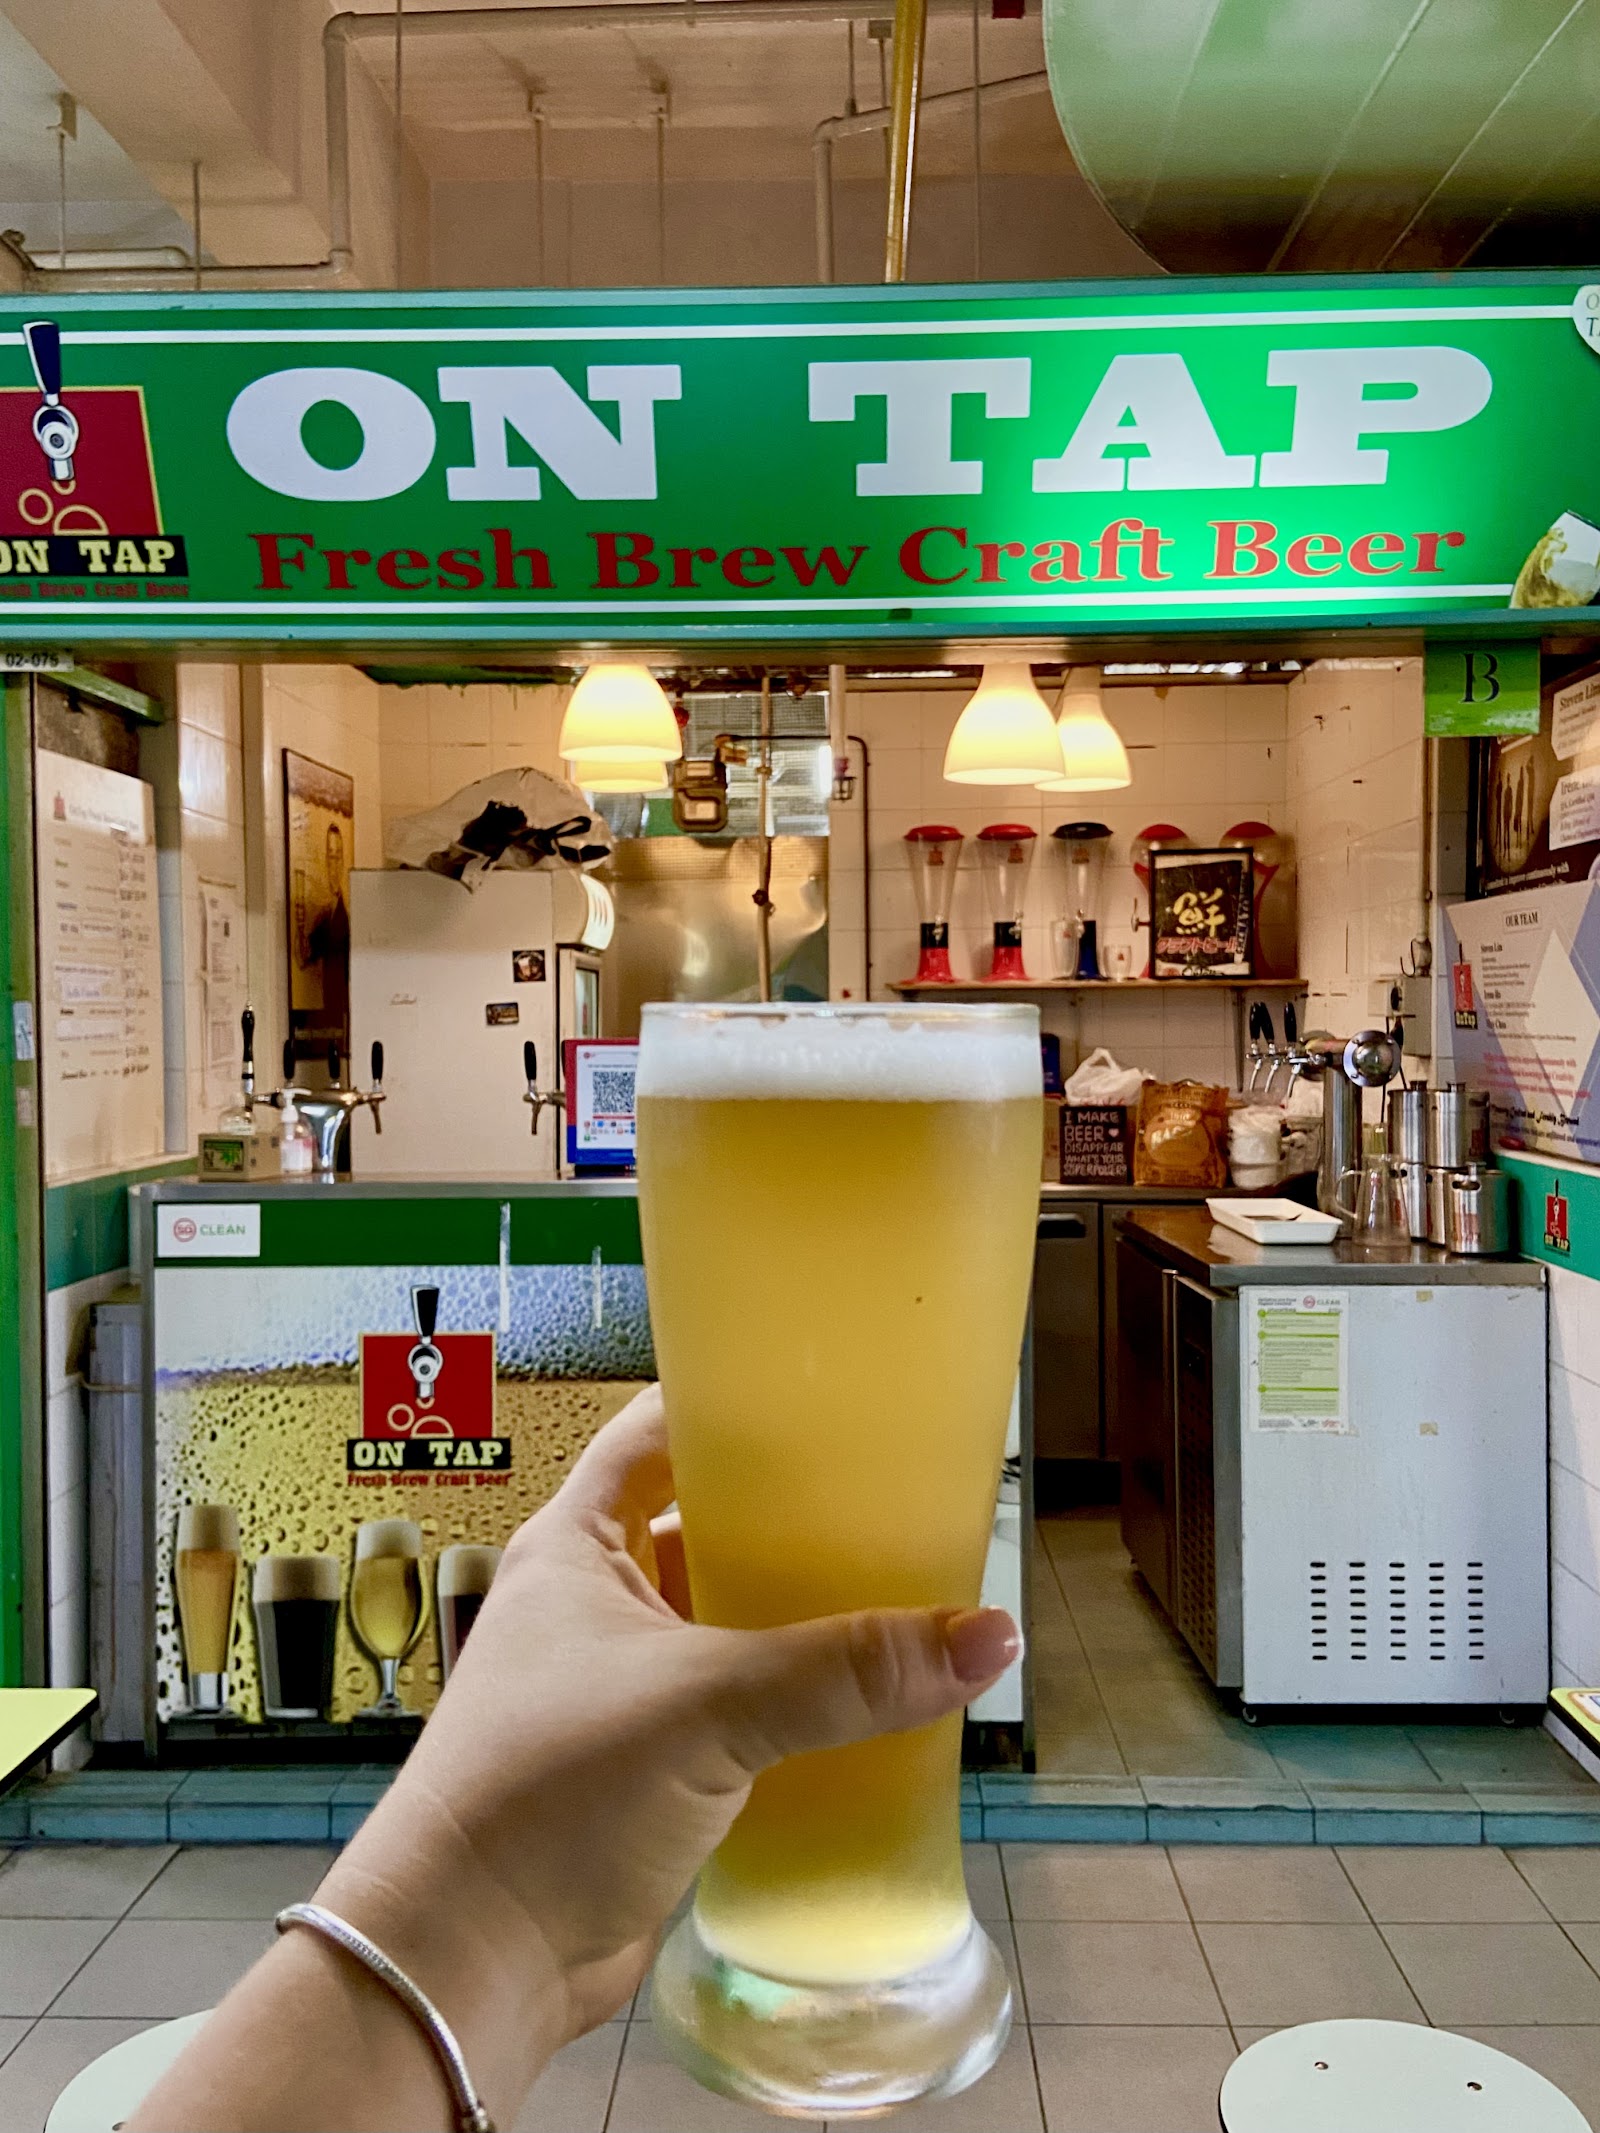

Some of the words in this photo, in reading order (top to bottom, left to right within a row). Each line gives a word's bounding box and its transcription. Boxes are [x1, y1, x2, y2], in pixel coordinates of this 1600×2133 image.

[226, 364, 682, 502] ON
[808, 346, 1493, 497] TAP
[78, 540, 175, 573] TAP
[250, 529, 556, 591] Fresh
[589, 531, 868, 588] Brew
[899, 518, 1175, 586] Craft
[1205, 520, 1466, 579] Beer
[1459, 652, 1500, 703] B
[1065, 1111, 1072, 1124] I
[1078, 1111, 1119, 1124] MAKE
[1064, 1125, 1104, 1142] BEER
[200, 1224, 246, 1236] CLEAN
[353, 1441, 406, 1467] ON
[428, 1441, 503, 1466] TAP
